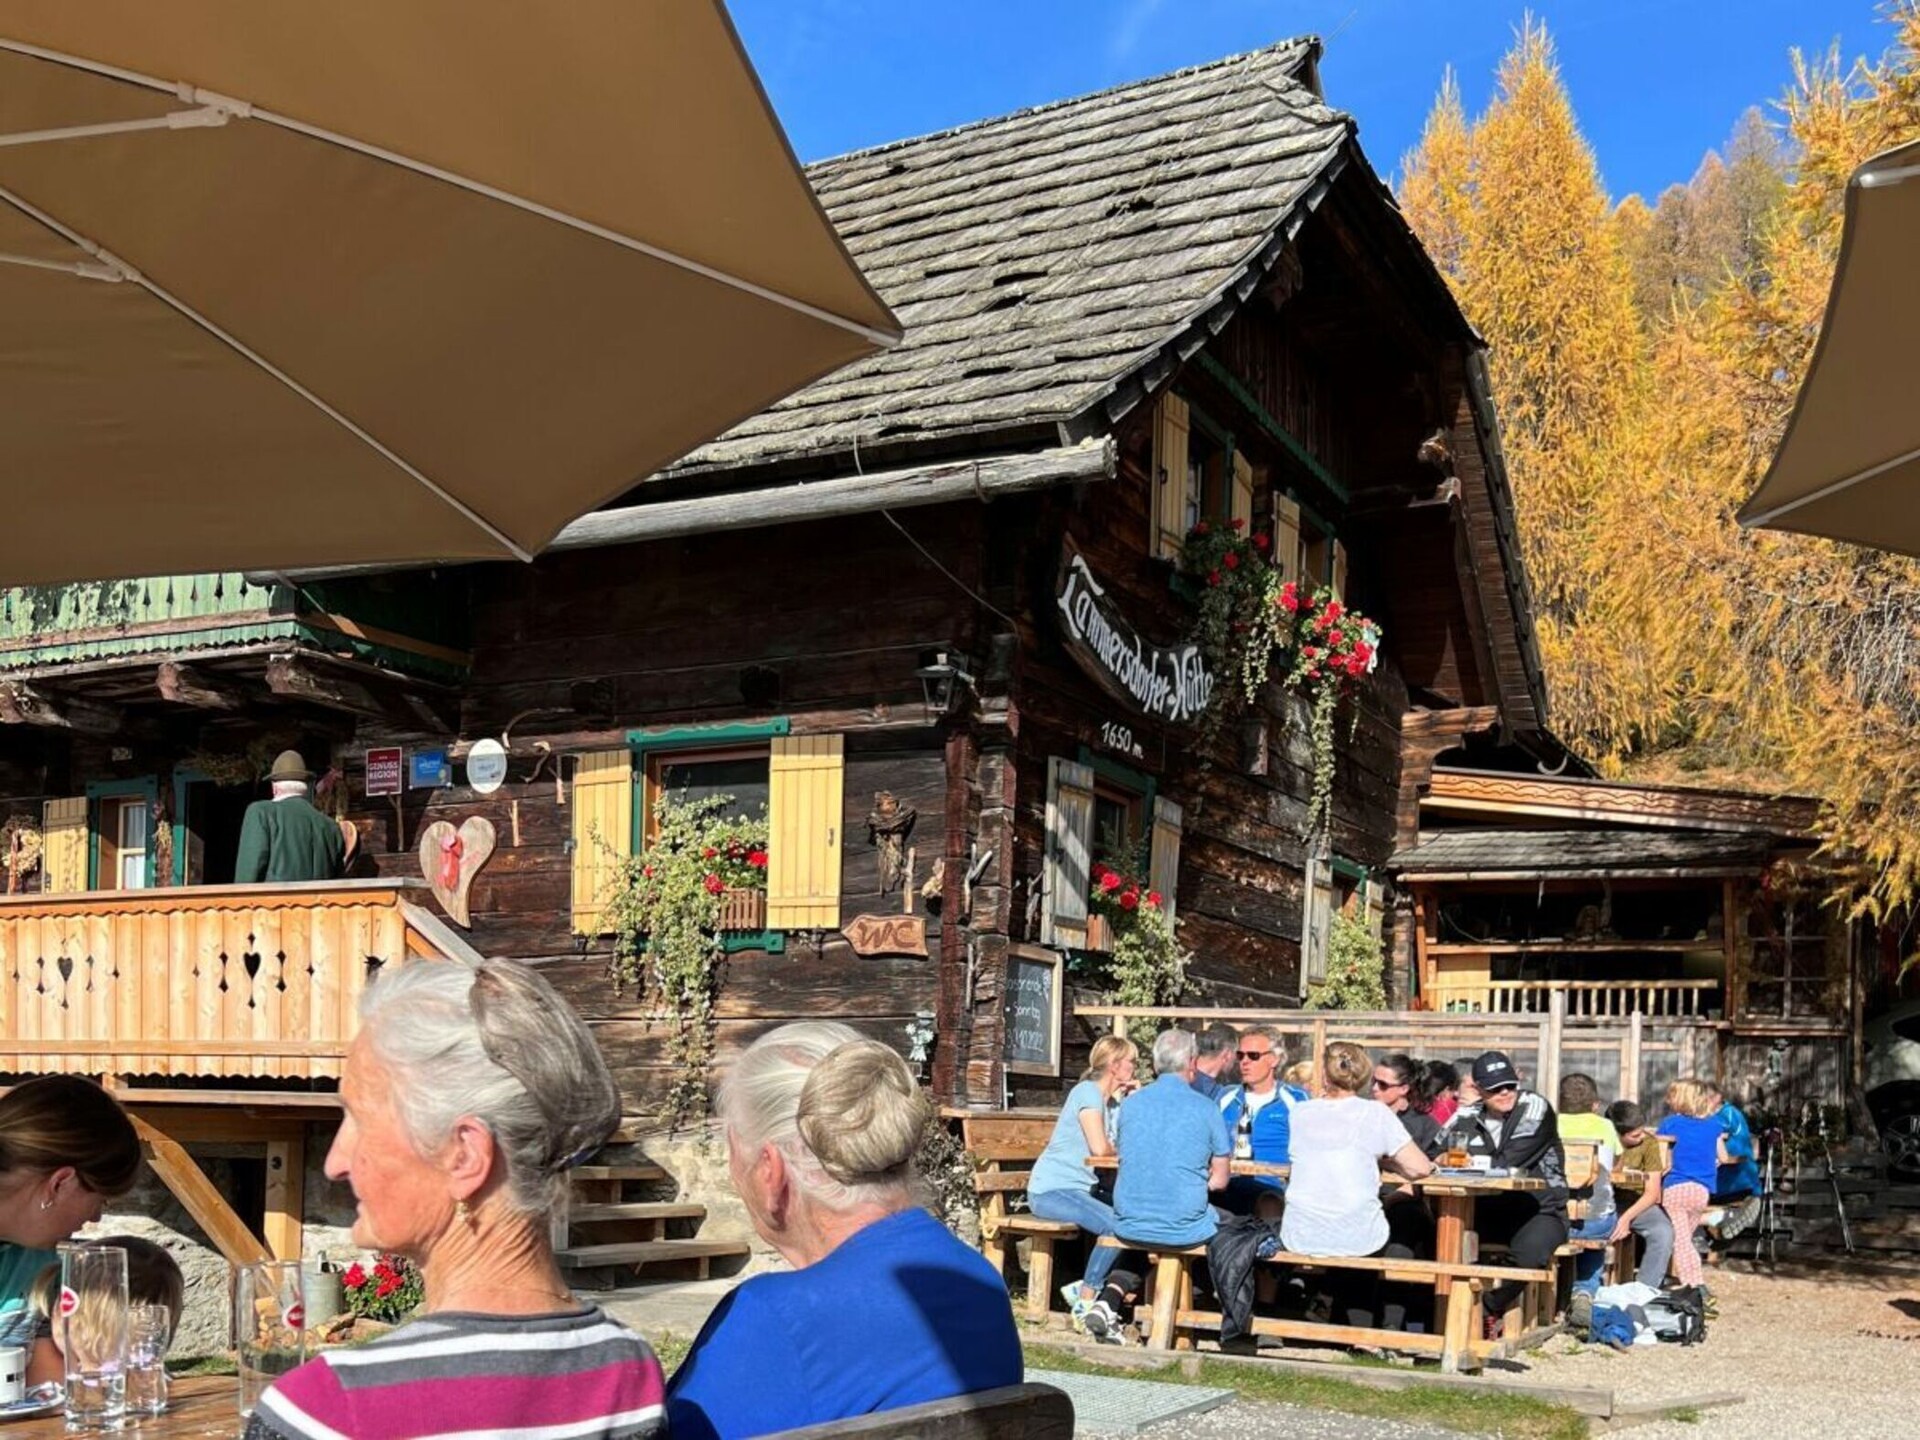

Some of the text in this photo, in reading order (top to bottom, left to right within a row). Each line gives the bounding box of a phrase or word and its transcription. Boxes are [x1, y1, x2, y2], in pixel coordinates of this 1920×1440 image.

[1101, 720, 1132, 753] 1650
[368, 760, 398, 771] GENUSS
[368, 770, 398, 780] REGION
[857, 920, 918, 949] WC
